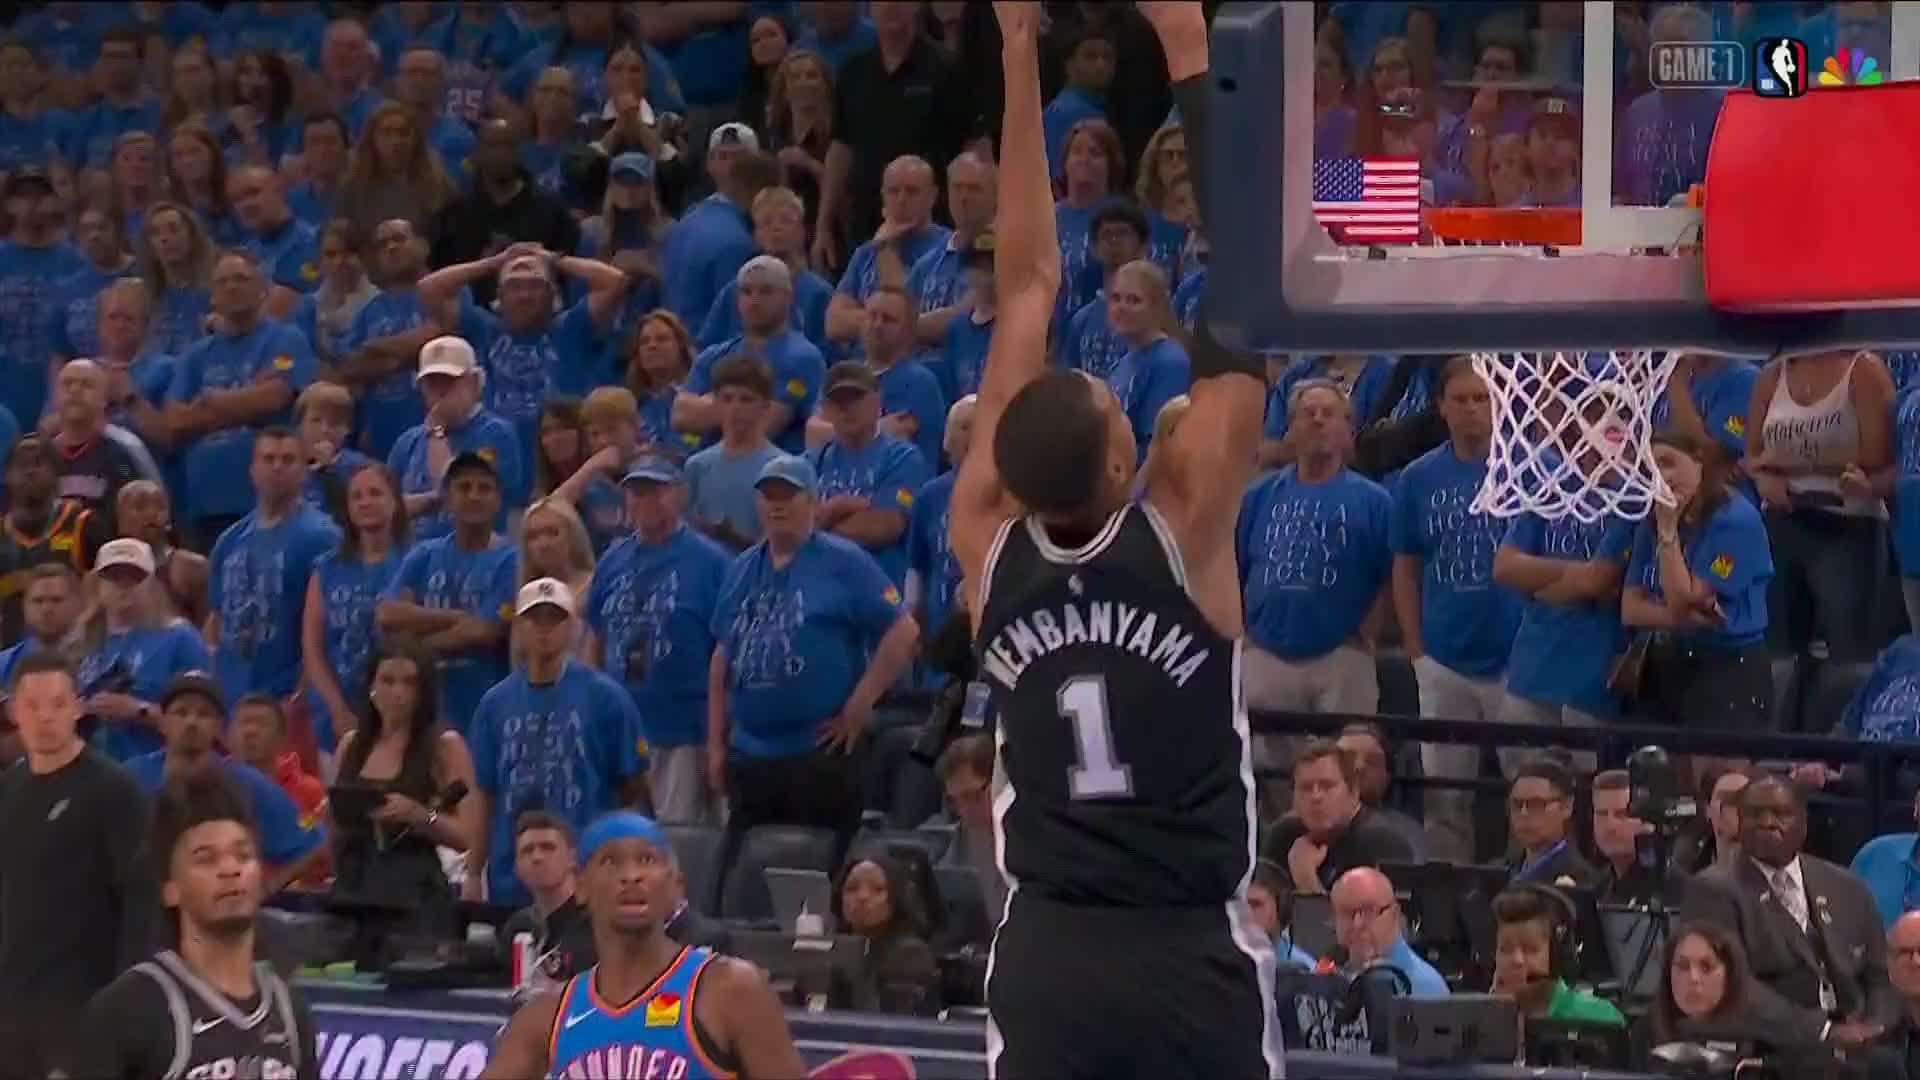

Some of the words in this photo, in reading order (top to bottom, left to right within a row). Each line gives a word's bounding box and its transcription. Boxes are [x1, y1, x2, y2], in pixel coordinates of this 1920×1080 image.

[1433, 559, 1490, 585] LOU
[984, 600, 1209, 691] WEMBANYAMA
[1056, 674, 1135, 800] 1
